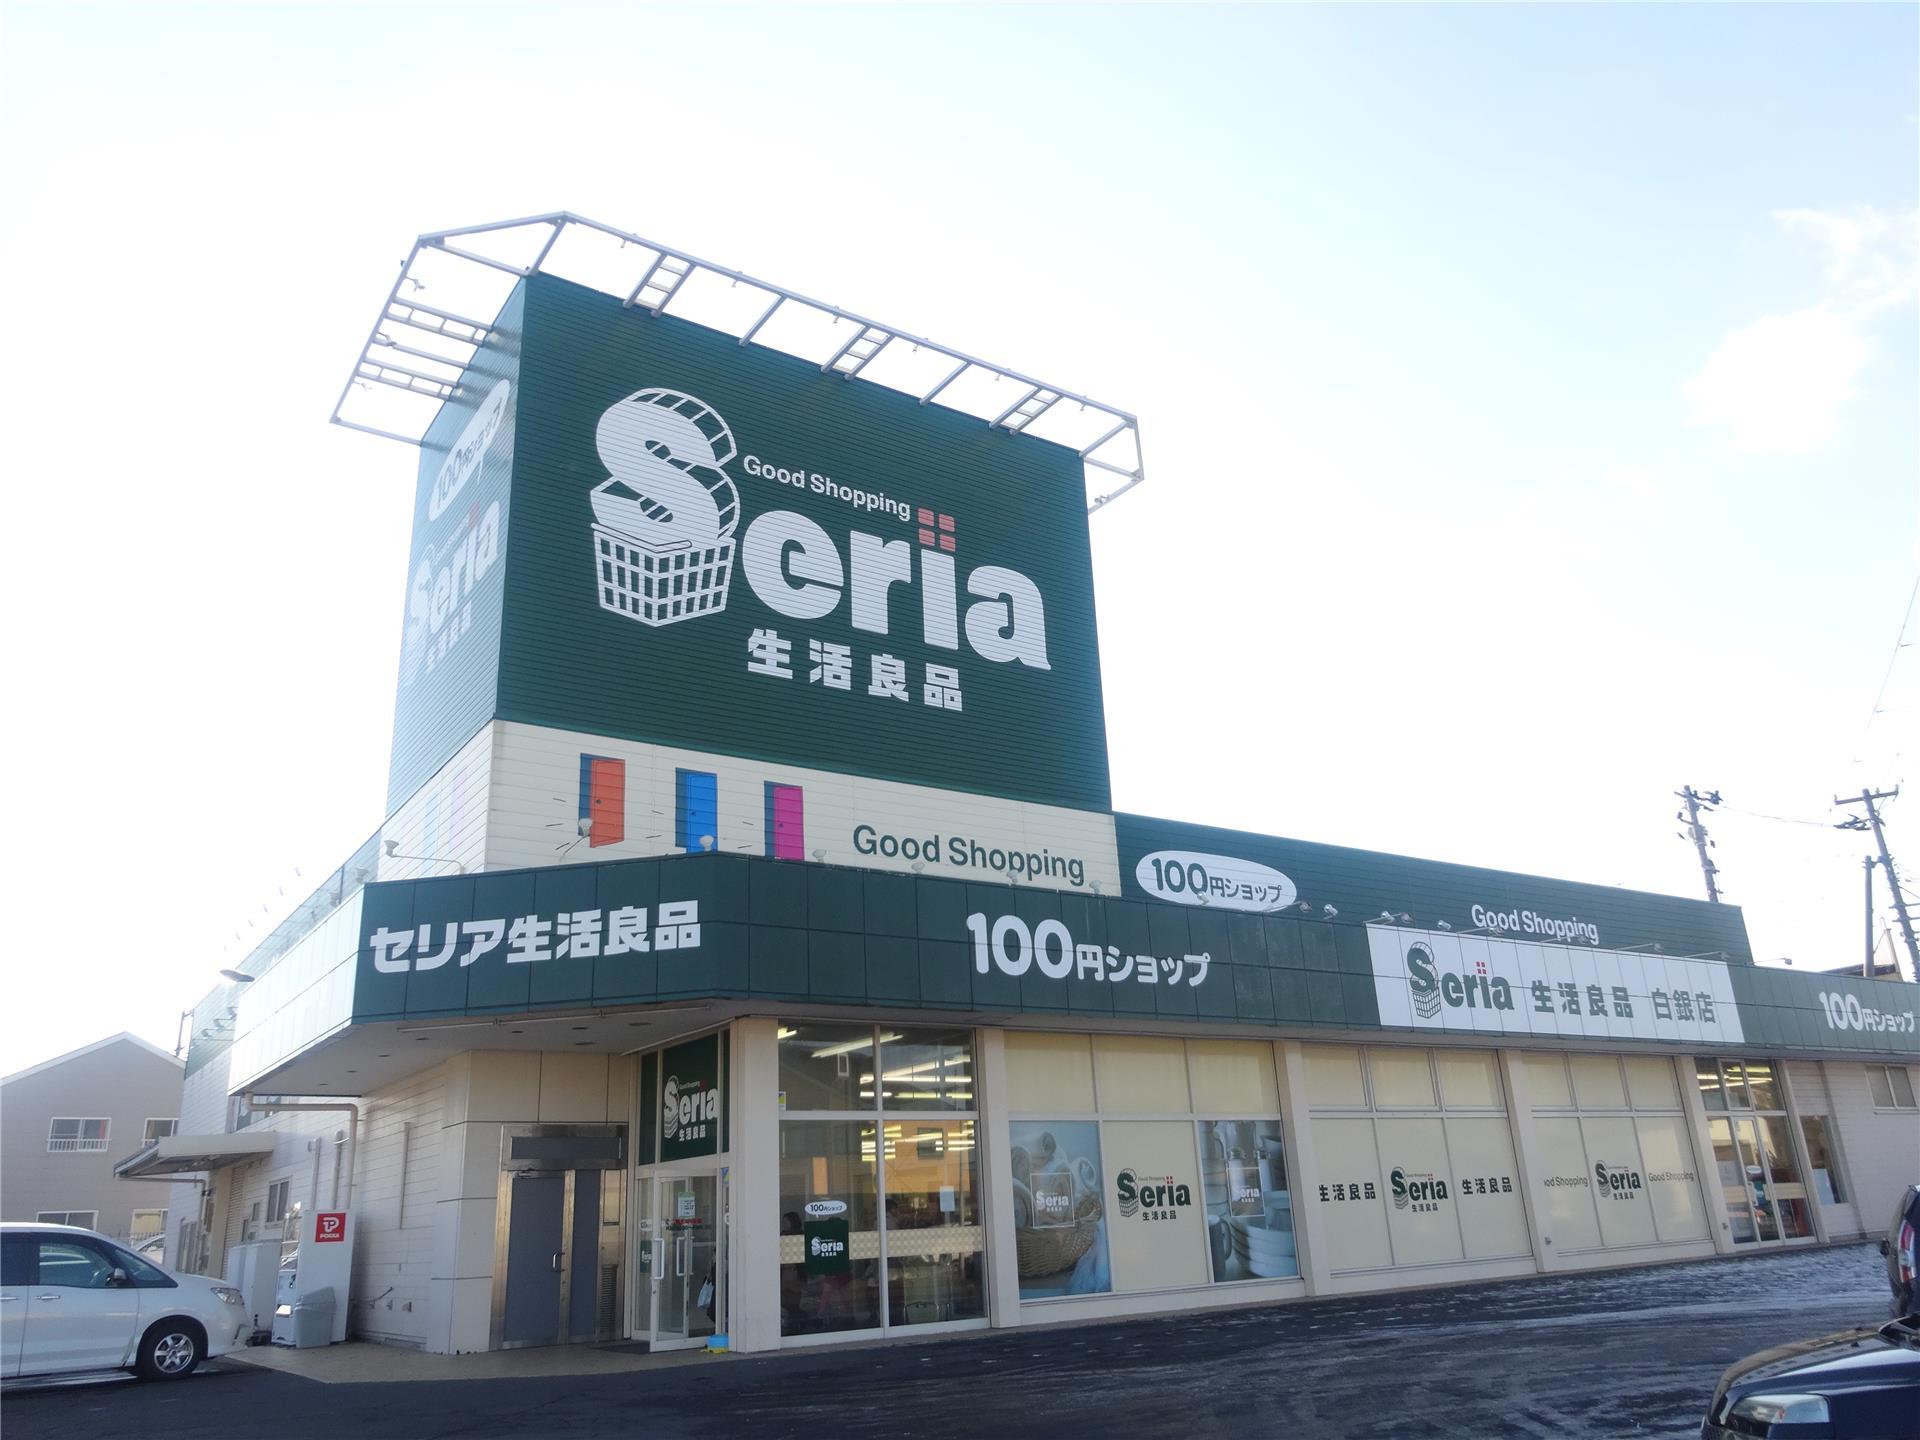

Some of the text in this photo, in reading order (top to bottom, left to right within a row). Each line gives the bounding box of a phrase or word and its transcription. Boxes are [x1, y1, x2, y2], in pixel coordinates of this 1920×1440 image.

[743, 455, 911, 522] Good Shopping
[590, 388, 1051, 671] Seria
[748, 628, 963, 712] 生活良品
[853, 824, 1085, 887] Good Shopping
[1151, 857, 1283, 903] 100円ショップ
[369, 899, 702, 974] セリア生活良品
[1471, 904, 1599, 945] Good Shopping
[966, 912, 1212, 988] 100円ショップ
[1406, 941, 1717, 1024] Seria 生活良品 白銀店
[1818, 991, 1916, 1033] 100円ショップ
[664, 1075, 721, 1139] Seria
[1116, 1167, 1192, 1218] Seria
[1319, 1182, 1376, 1202] 生活良品
[1390, 1166, 1448, 1210] Seria
[1462, 1176, 1512, 1195] 生活良品
[1555, 1175, 1589, 1188] Shopping
[1595, 1160, 1642, 1198] Seria
[1142, 1209, 1177, 1221] 生活良品
[811, 1236, 844, 1256] Seria
